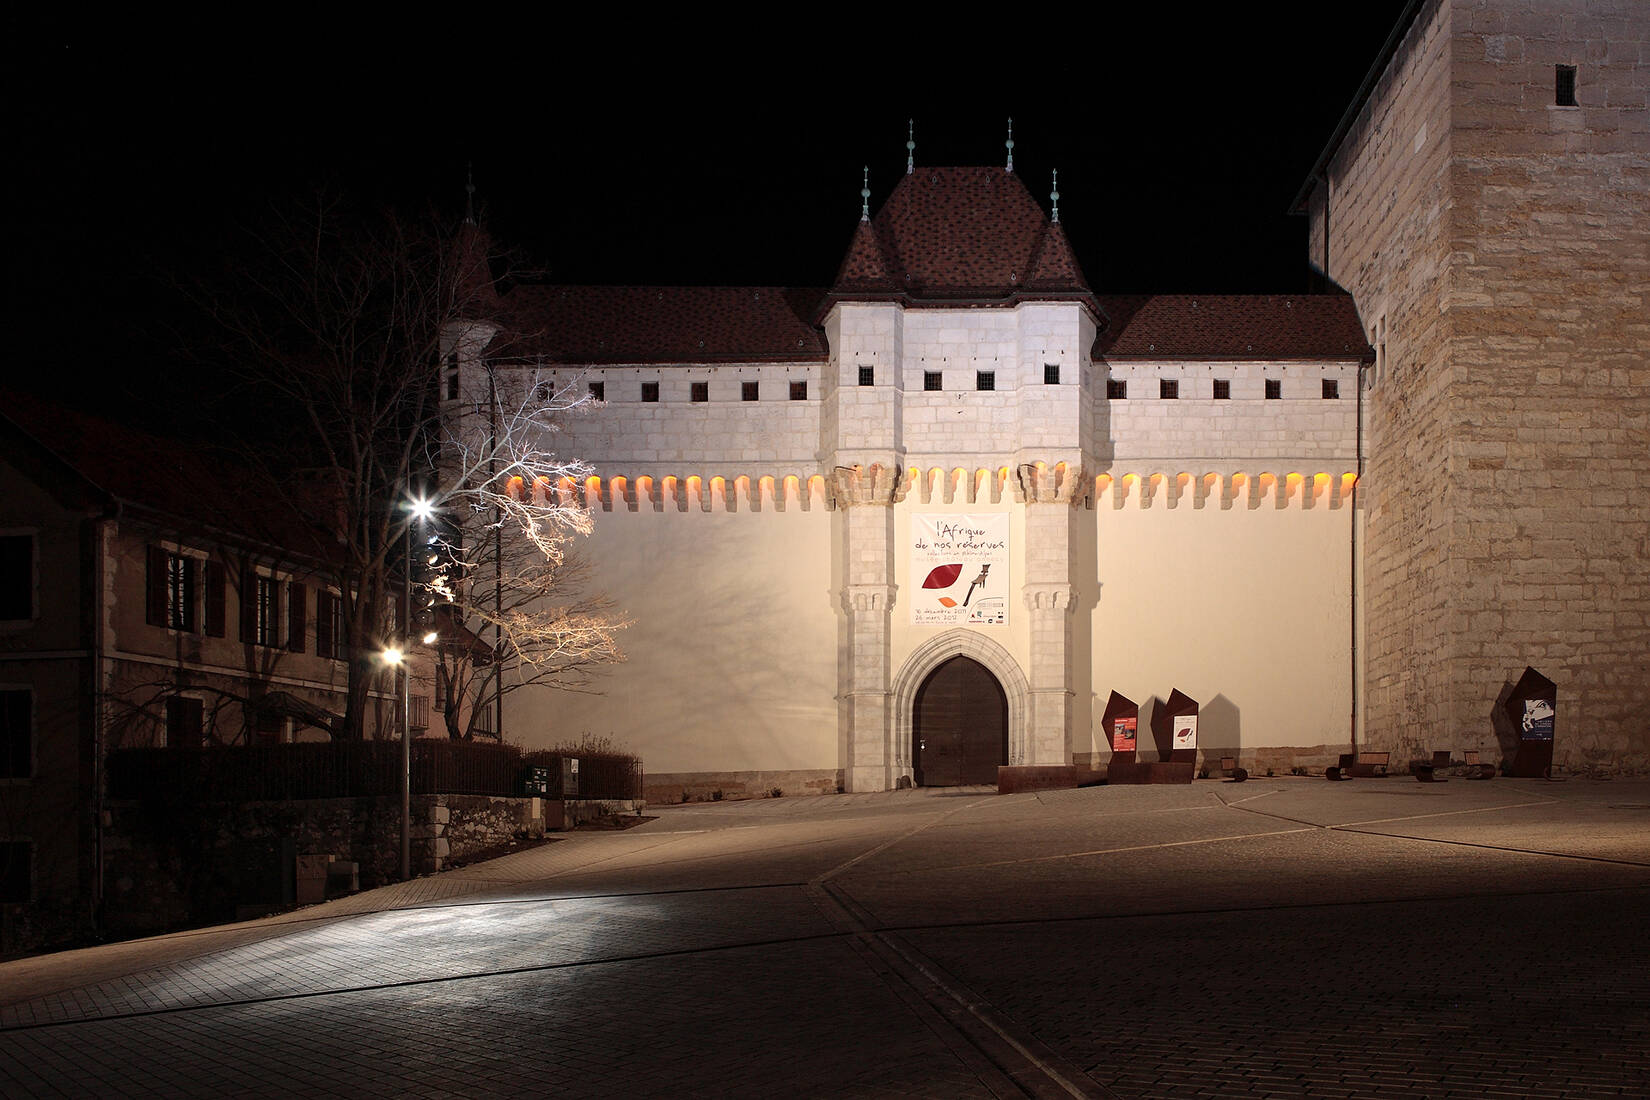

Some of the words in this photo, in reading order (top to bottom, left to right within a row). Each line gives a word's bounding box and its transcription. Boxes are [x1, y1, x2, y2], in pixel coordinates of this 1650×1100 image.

[937, 521, 985, 541] l'Afrique
[915, 538, 928, 549] de
[957, 541, 1004, 549] réserves
